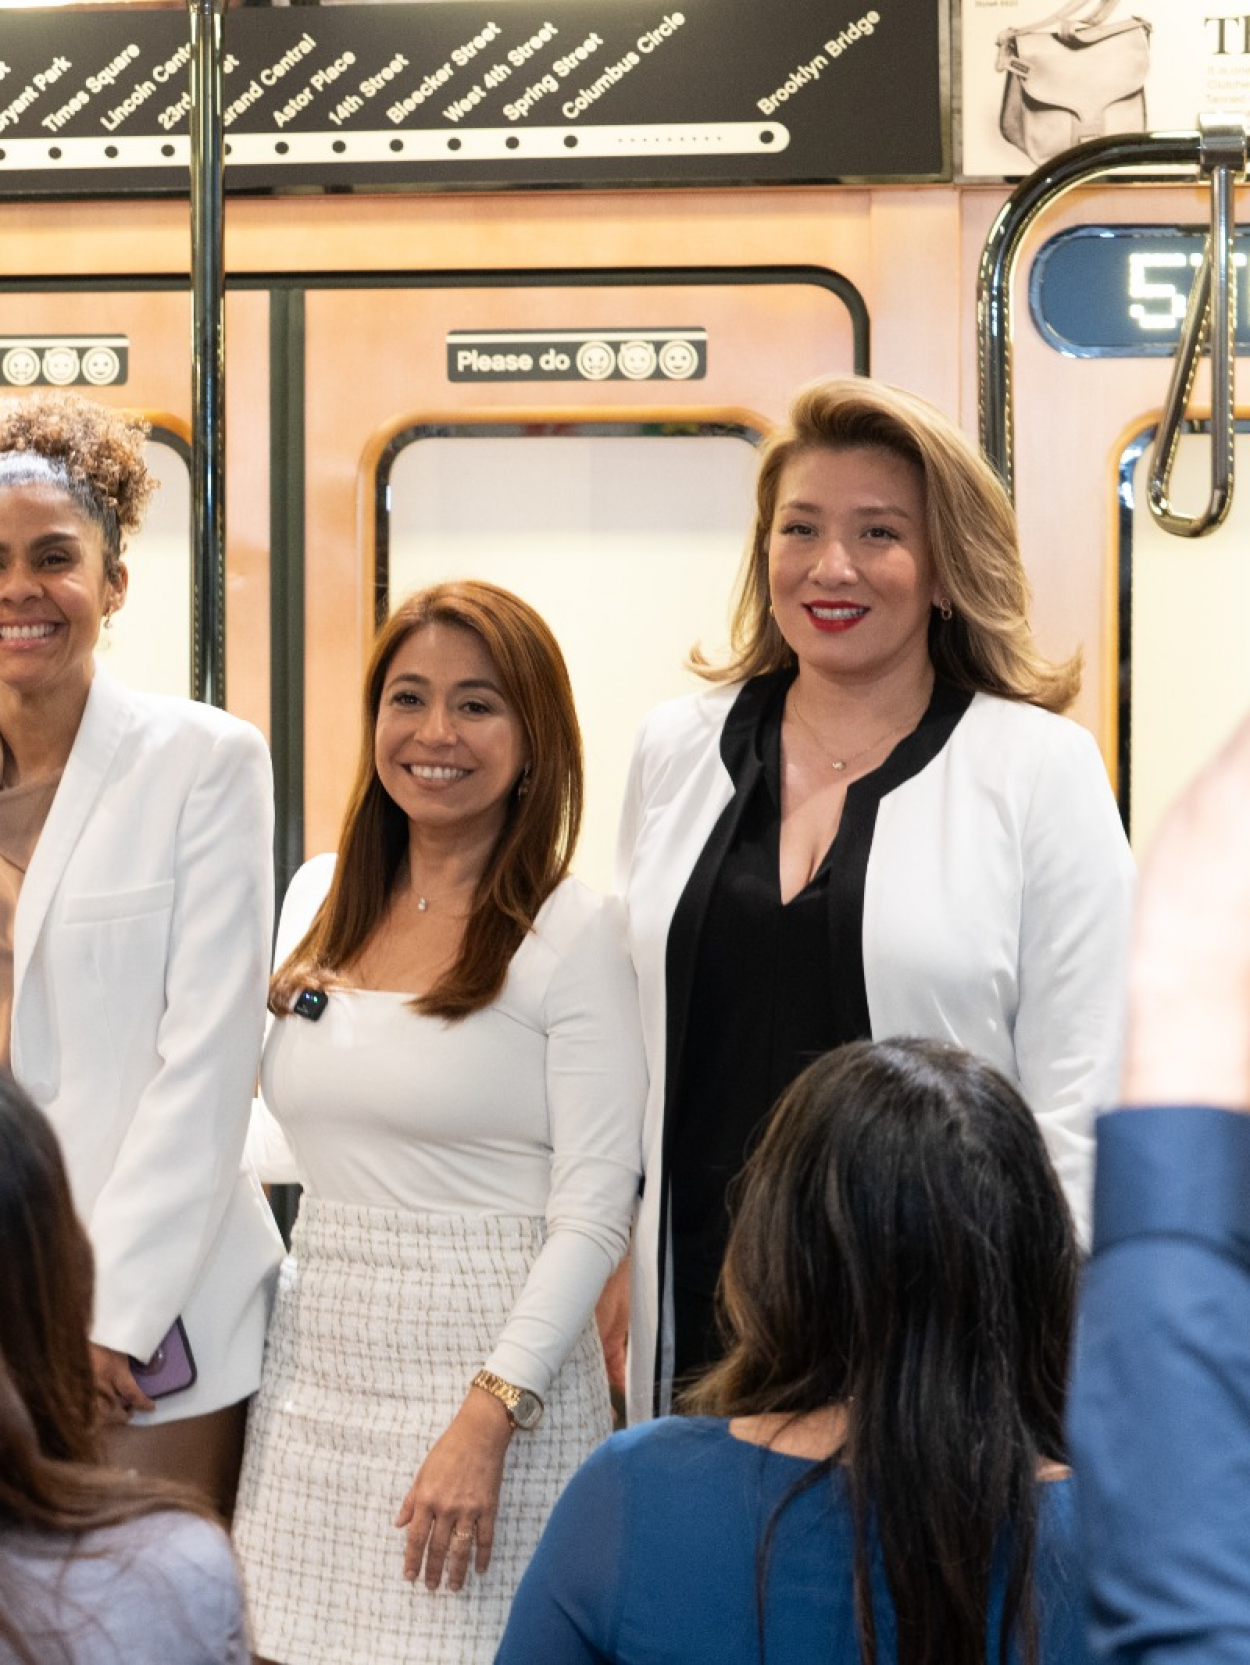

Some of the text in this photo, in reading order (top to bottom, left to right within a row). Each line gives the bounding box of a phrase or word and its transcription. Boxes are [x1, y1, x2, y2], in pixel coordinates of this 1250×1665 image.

[32, 55, 73, 92] Park
[260, 32, 317, 87] Central
[385, 21, 503, 125] Bleecker Street
[441, 20, 559, 123] West 4th Street
[561, 11, 686, 120] Columbus Circle
[756, 10, 881, 115] Brooklyn Bridge
[1204, 15, 1250, 55] T
[41, 43, 141, 132] Times Square
[99, 80, 157, 132] Lincoln
[272, 50, 357, 128] Astor Place
[328, 52, 410, 126] 14th Street
[502, 32, 604, 121] Spring Street
[456, 348, 571, 372] Please do
